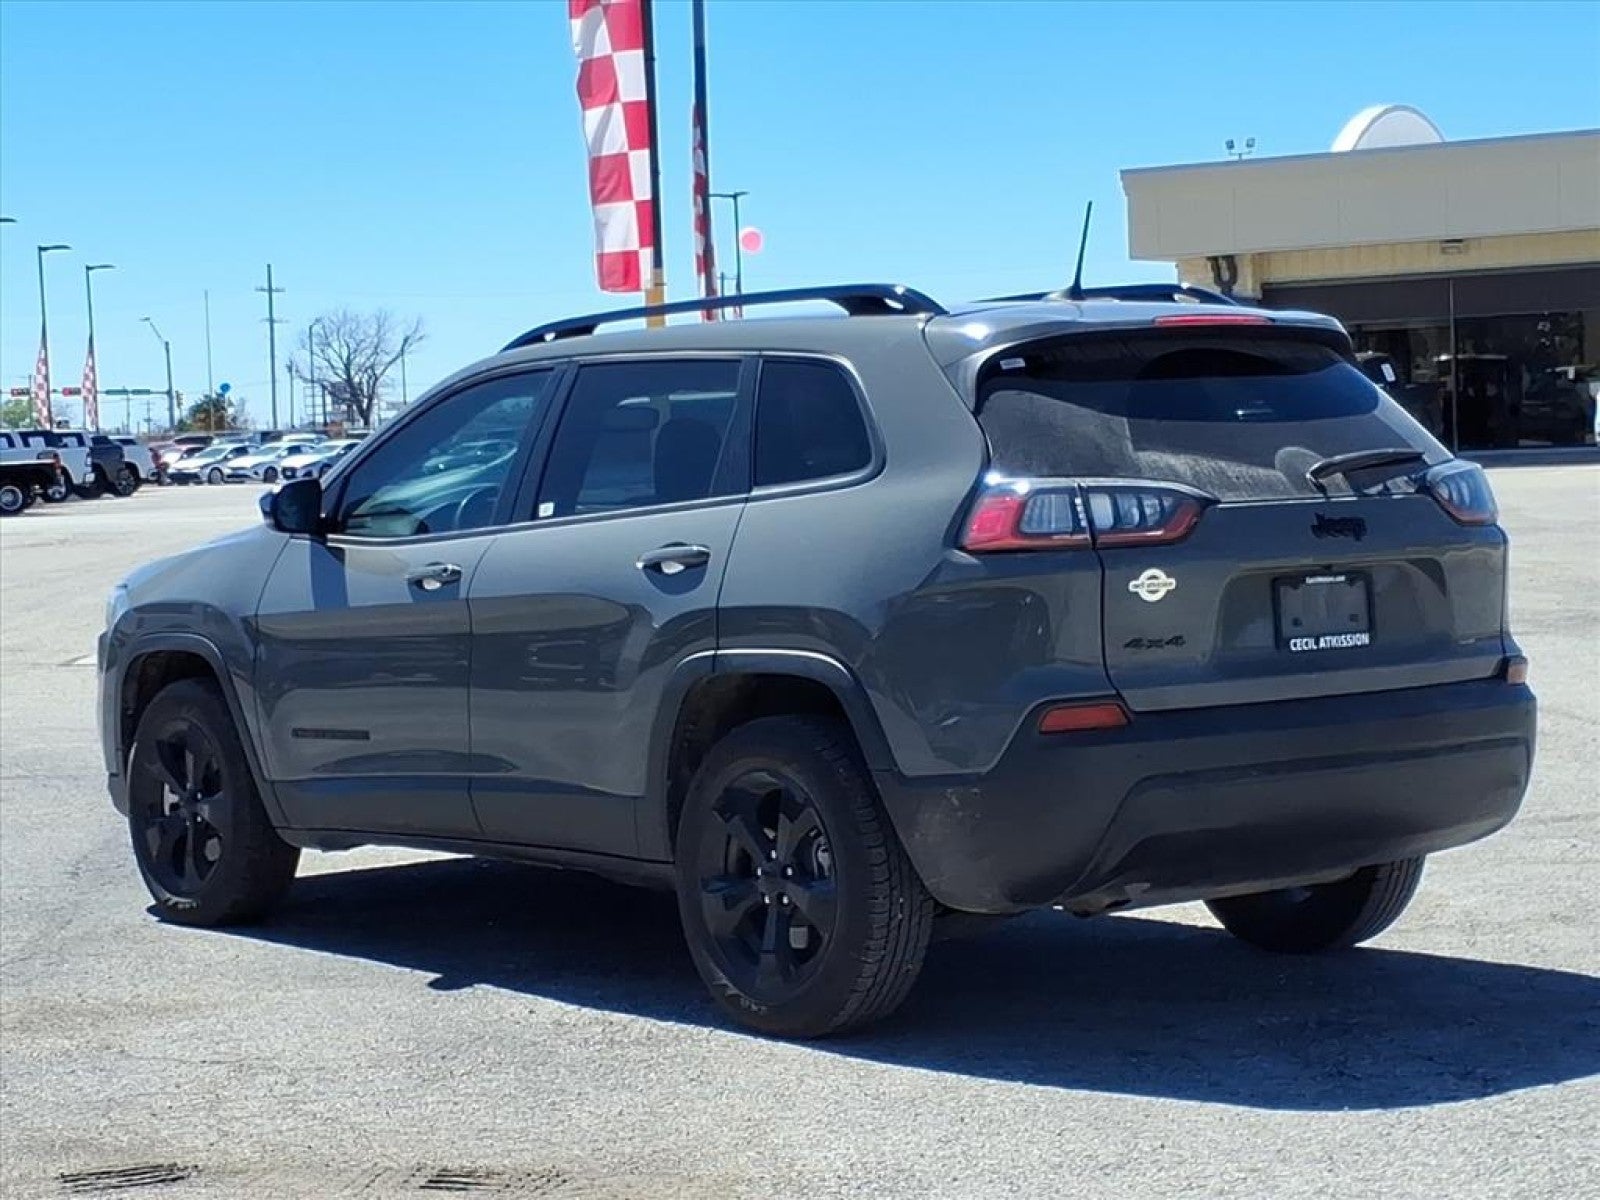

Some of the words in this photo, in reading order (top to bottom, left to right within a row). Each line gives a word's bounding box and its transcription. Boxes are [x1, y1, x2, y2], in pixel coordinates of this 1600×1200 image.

[1310, 512, 1367, 541] Jeep
[1289, 637, 1317, 651] CECIL
[1319, 632, 1370, 649] ATKISSION
